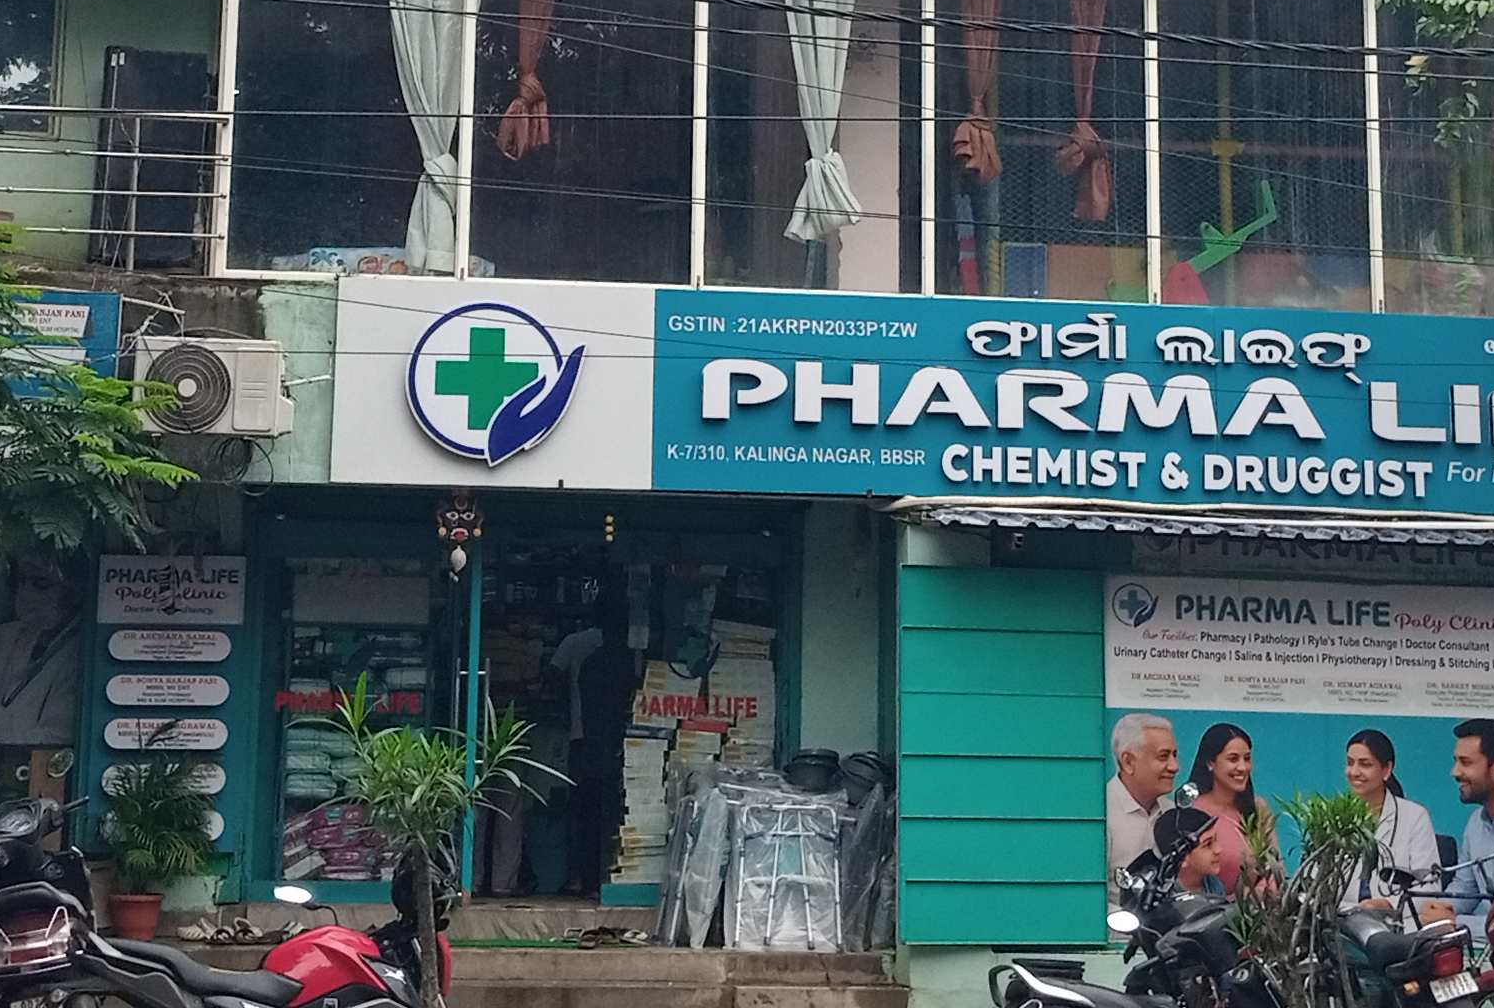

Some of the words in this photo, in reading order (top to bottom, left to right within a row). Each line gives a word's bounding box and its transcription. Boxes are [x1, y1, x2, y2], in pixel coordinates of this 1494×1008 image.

[64, 311, 86, 320] PANI
[668, 315, 726, 333] GSTIN
[701, 357, 1327, 440] PHARMA
[667, 444, 730, 463] K-7/310,
[734, 446, 808, 464] KALINGA
[812, 448, 875, 467] NAGAR,
[880, 449, 926, 466] BBSR
[941, 443, 1147, 489] CHEMIST
[1160, 453, 1189, 489] &
[1203, 453, 1433, 499] DRUGGIST
[1447, 461, 1486, 483] For
[105, 568, 193, 584] PHARA
[1175, 594, 1317, 625] PHARMA
[1327, 600, 1391, 627] LIFE
[1394, 612, 1445, 634] Poly
[1199, 632, 1246, 646] Pharmacy
[1254, 633, 1300, 647] Pathology
[1308, 635, 1336, 648] Ryle's
[1338, 636, 1361, 648] Tube
[1362, 637, 1398, 650] Change
[1405, 638, 1436, 650] Doctor
[1438, 640, 1490, 652] Consultant
[1113, 646, 1148, 660] Urinary
[1150, 647, 1189, 660] Catheter
[1191, 648, 1227, 662] Change
[1234, 650, 1263, 662] Saline
[1265, 651, 1272, 662] &
[1274, 652, 1314, 665] Injection
[1321, 653, 1388, 668] Physiotherapy
[1395, 655, 1436, 669] Dressing
[1438, 656, 1445, 667] &
[1448, 657, 1490, 672] Stitching
[714, 695, 758, 718] LIFE
